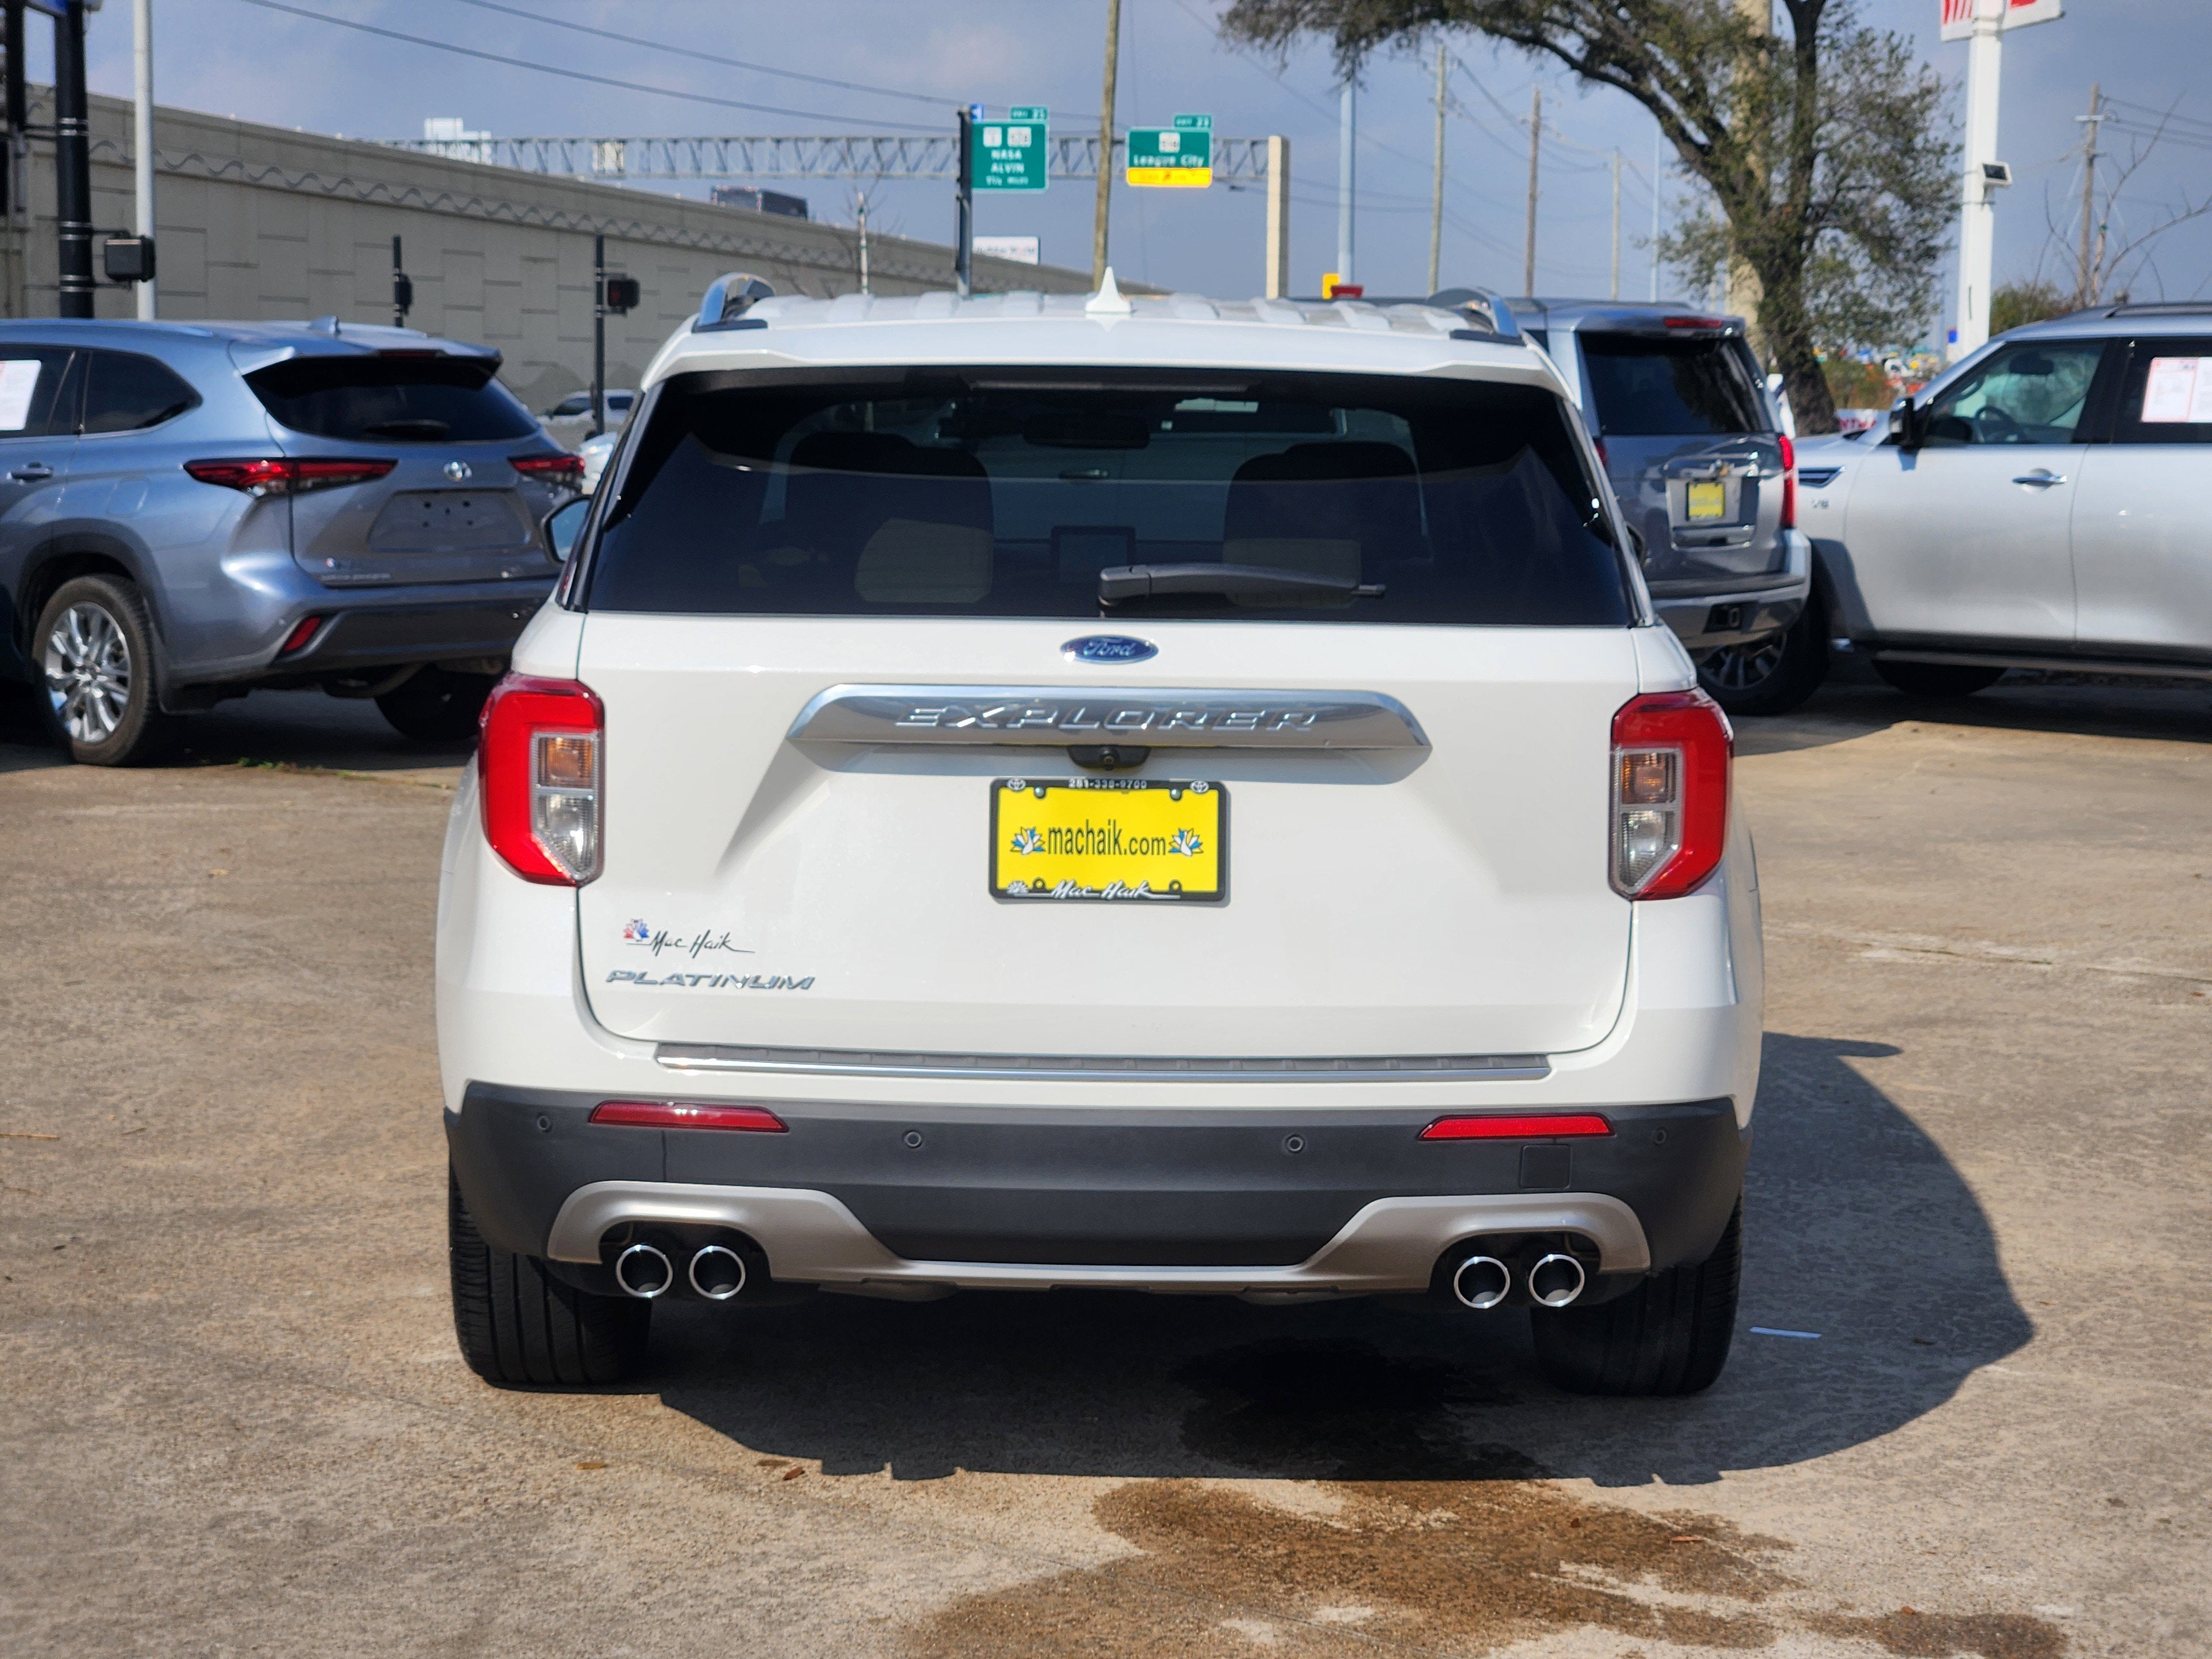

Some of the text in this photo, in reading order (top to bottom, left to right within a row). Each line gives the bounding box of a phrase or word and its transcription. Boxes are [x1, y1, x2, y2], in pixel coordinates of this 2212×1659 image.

[991, 149, 1022, 160] NASA
[1134, 154, 1205, 168] League City
[1082, 638, 1137, 657] Ford
[895, 704, 1317, 731] EXPLORER
[1047, 818, 1166, 856] machaik.com
[1049, 879, 1160, 900] Mac Haik
[649, 929, 747, 959] Mac Haik
[606, 969, 817, 991] PLATINUM
